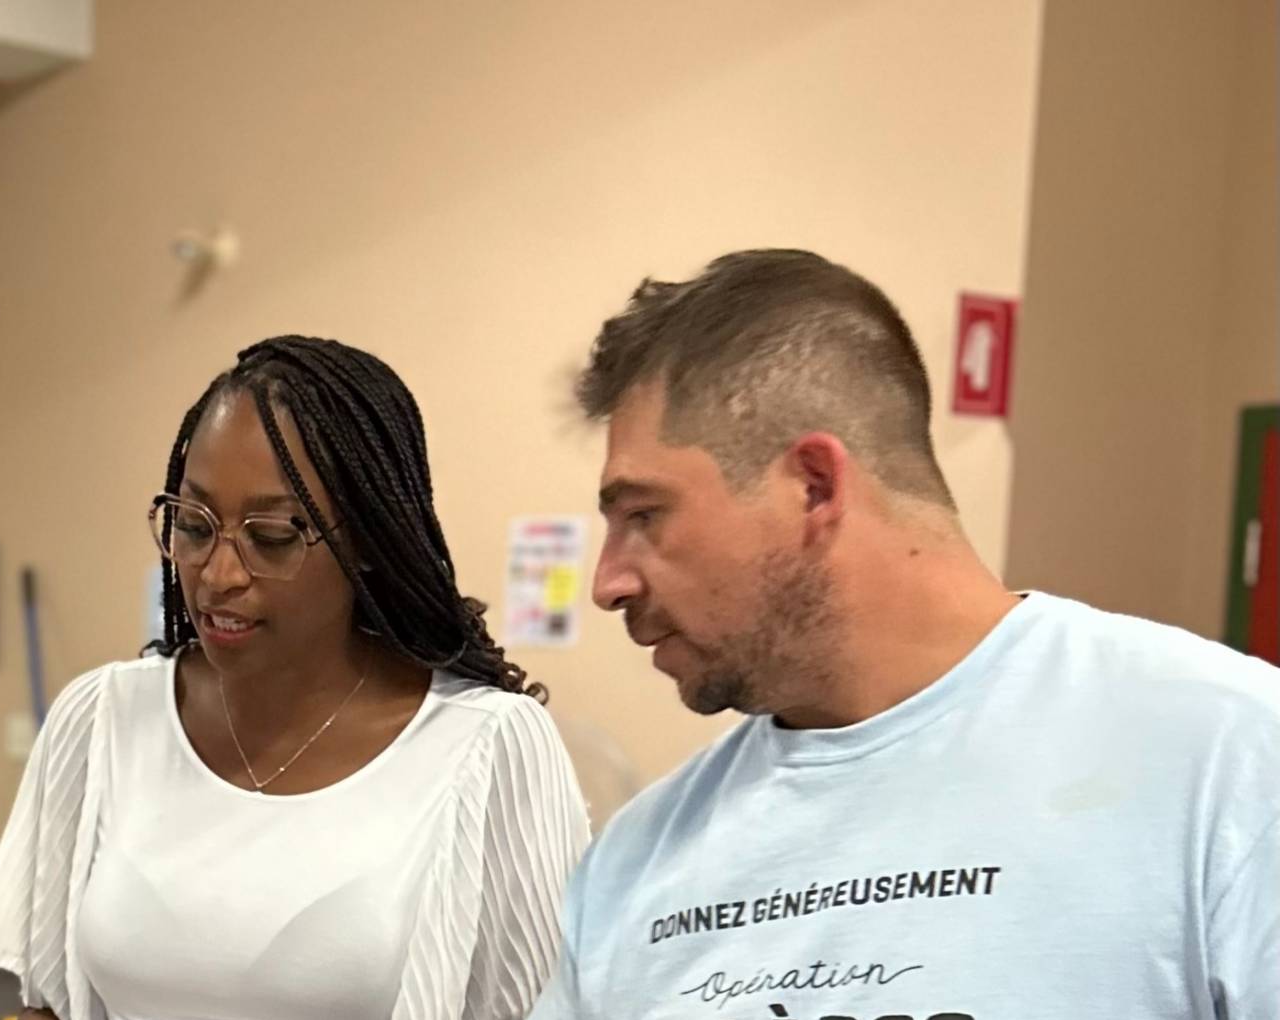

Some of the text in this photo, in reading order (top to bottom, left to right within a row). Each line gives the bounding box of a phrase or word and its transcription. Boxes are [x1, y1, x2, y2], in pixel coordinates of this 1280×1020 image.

[650, 866, 1002, 944] DONNEZ GÉNÉREUSEMENT
[681, 960, 923, 1009] Opération
